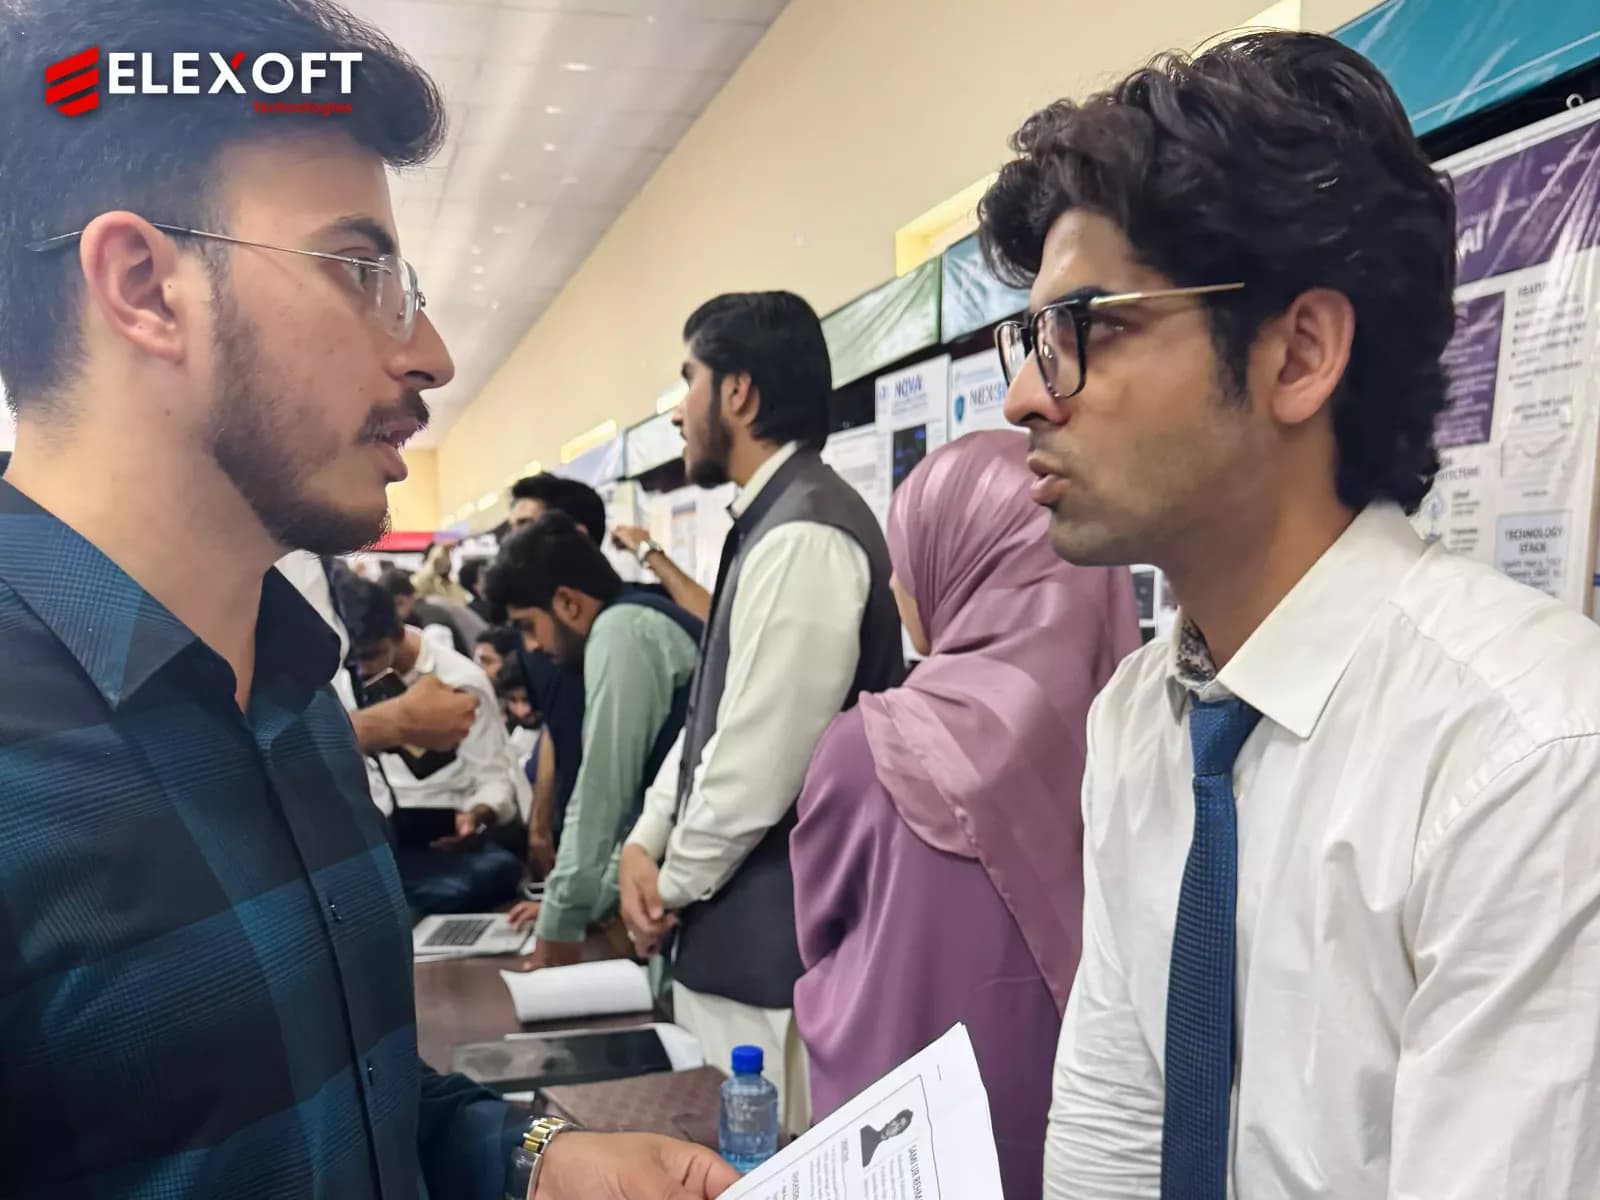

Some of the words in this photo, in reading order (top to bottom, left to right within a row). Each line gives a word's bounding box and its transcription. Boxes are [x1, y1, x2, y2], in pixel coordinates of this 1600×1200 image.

[894, 374, 922, 397] NOVA
[1504, 526, 1563, 541] TECHNOLOGY
[1519, 542, 1547, 553] STACK
